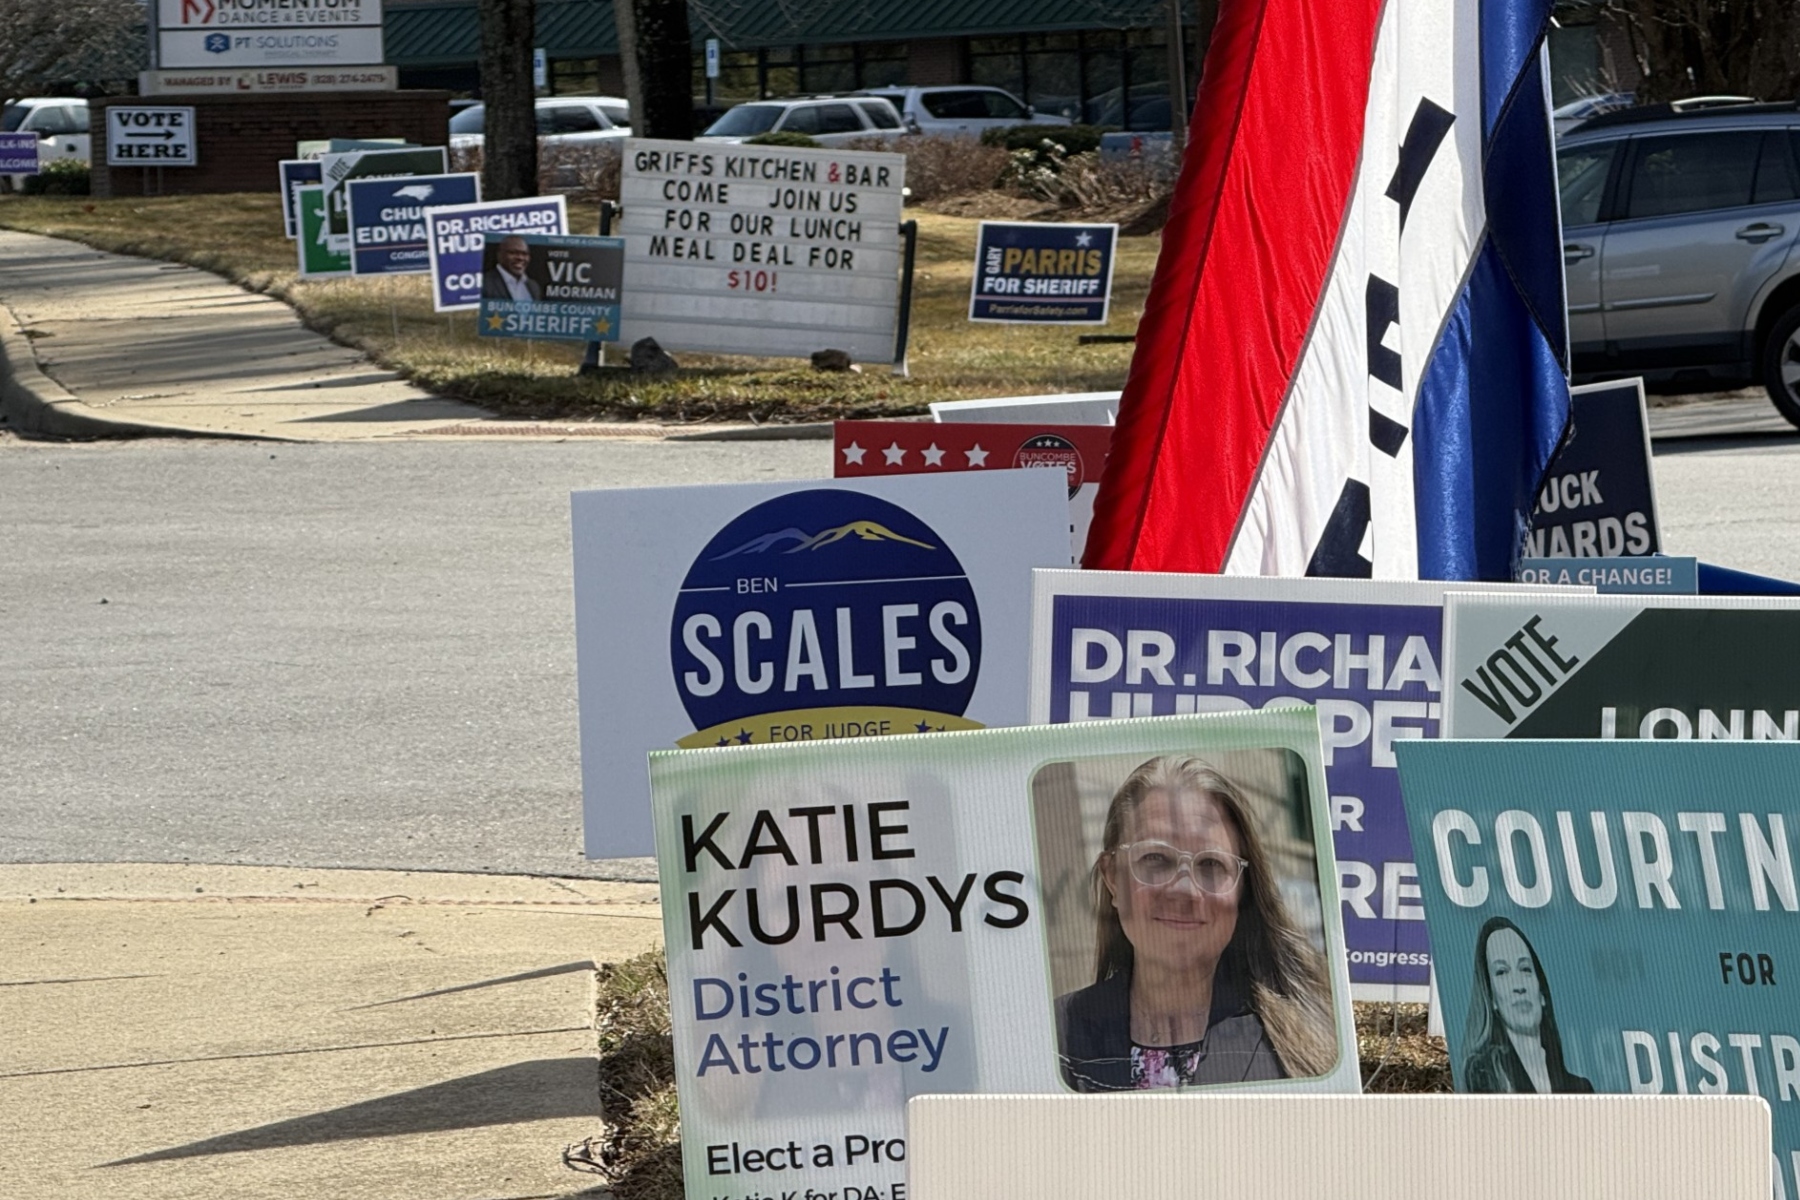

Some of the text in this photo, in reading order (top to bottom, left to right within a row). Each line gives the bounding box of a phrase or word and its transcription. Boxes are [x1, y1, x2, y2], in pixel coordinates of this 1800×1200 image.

[218, 11, 279, 24] DANCE
[296, 10, 360, 23] EVENTS
[235, 35, 338, 48] PT SOLUTIONS
[257, 73, 307, 85] LEWIS
[116, 112, 184, 127] VOTE
[115, 144, 187, 158] HERE
[326, 157, 351, 182] VOTE
[635, 151, 714, 176] GRIFFS
[725, 156, 817, 182] KITCHEN
[663, 179, 858, 213] COME JOIN US
[664, 209, 861, 242] FOR OUR LUNCH
[548, 250, 569, 258] VOTE
[649, 235, 854, 270] MEAL DEAL FOR
[985, 247, 1003, 274] GARY
[1004, 248, 1102, 276] PARRIS
[547, 261, 592, 283] VIC
[727, 270, 778, 292] $10!
[546, 285, 616, 299] MORMAN
[983, 277, 1100, 295] FOR SHERIFF
[488, 301, 611, 316] BUNCOMBE COUNTY
[506, 314, 592, 334] SHERIFF
[1020, 452, 1076, 461] BUNCOMBE
[1534, 470, 1604, 514] UCK
[736, 577, 778, 594] BEN
[1557, 569, 1574, 583] A
[1578, 568, 1672, 585] CHANGE!
[682, 600, 971, 697] SCALES
[1460, 614, 1580, 725] VOTE
[770, 720, 891, 742] FOR JUDGE
[681, 800, 916, 873] KATIE
[1432, 809, 1800, 912] COURTN
[688, 870, 1030, 950] KURDYS
[1719, 952, 1776, 985] FOR
[693, 966, 903, 1021] District
[696, 1026, 950, 1077] Attorney
[707, 1134, 906, 1176] Elect a Pro
